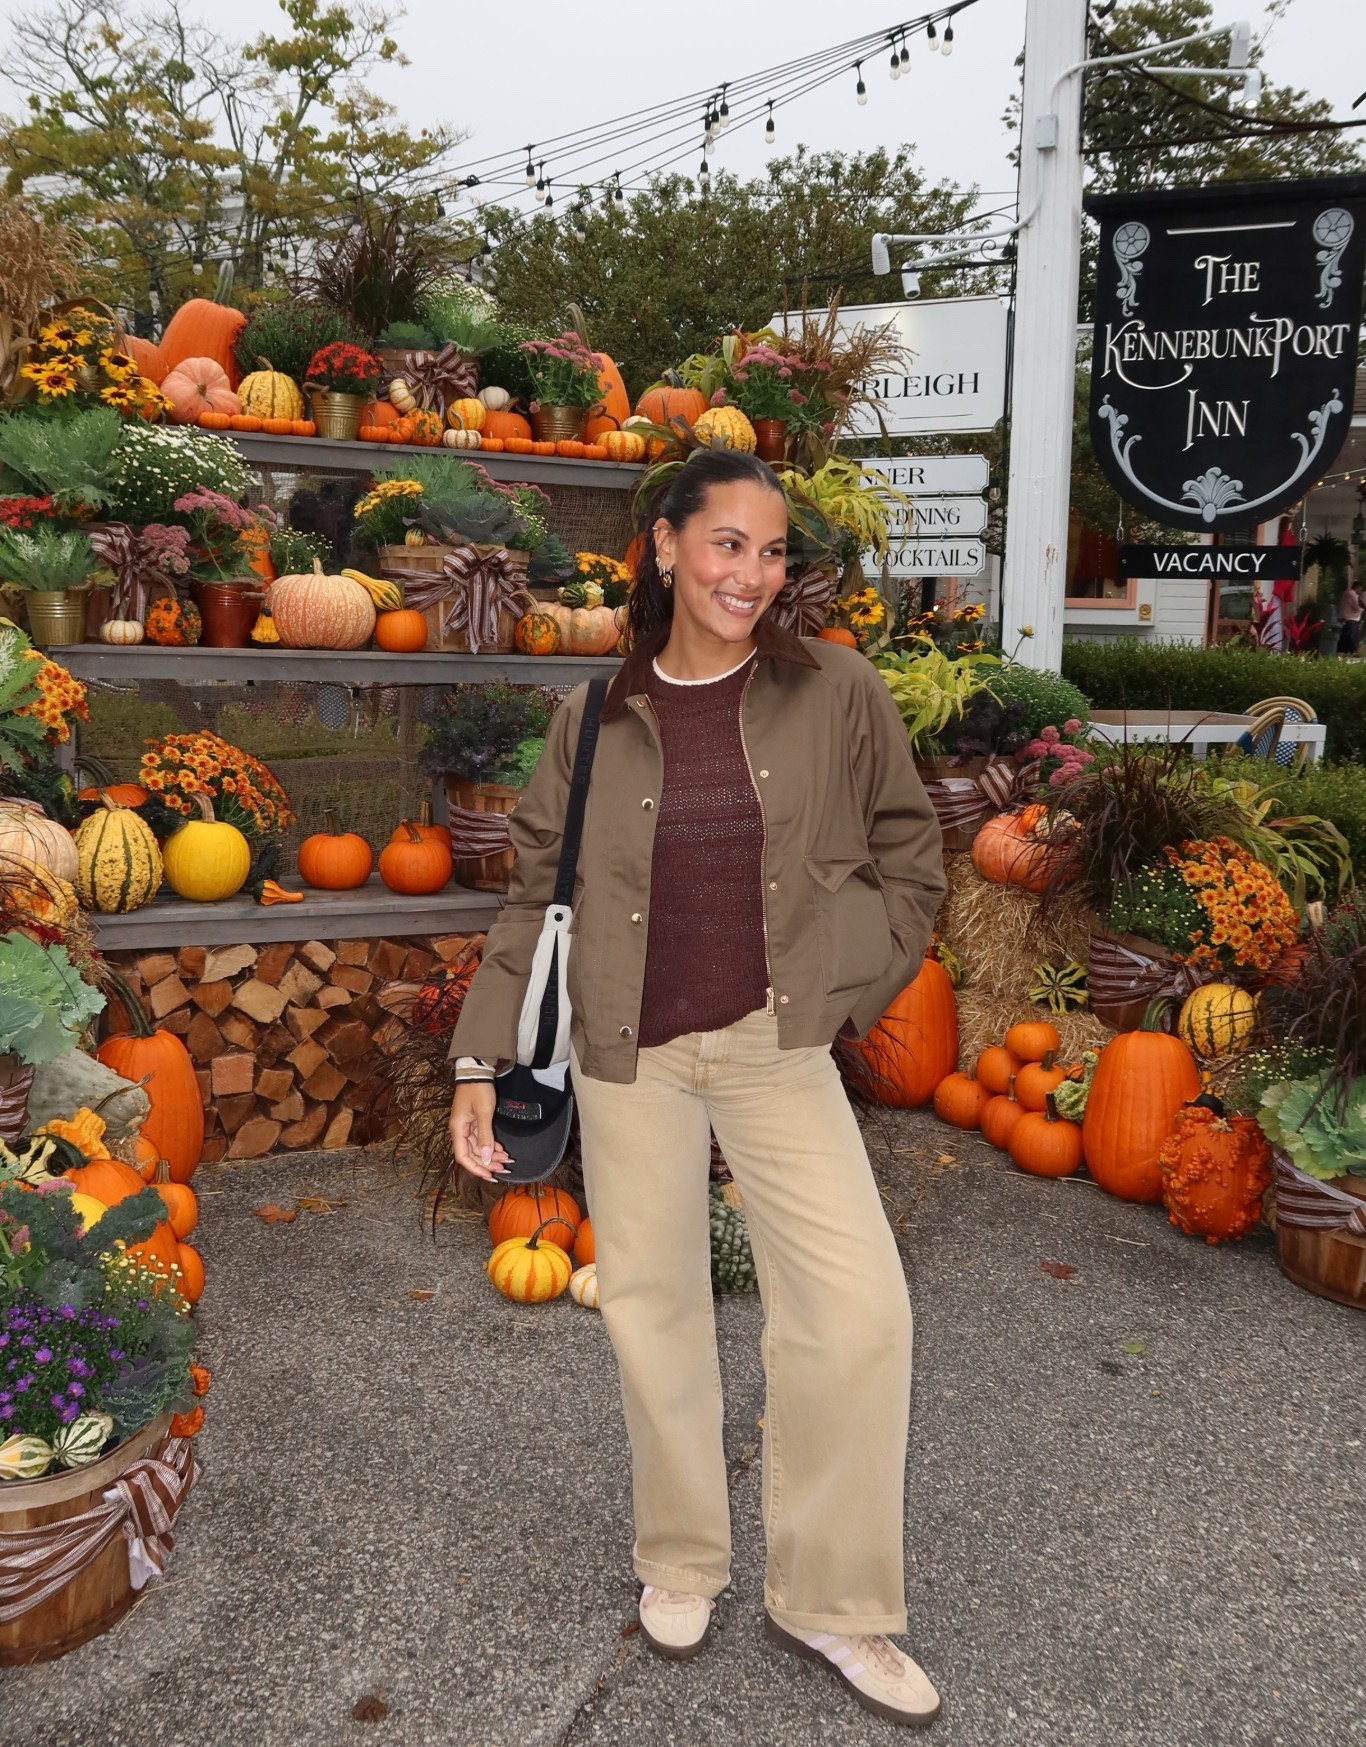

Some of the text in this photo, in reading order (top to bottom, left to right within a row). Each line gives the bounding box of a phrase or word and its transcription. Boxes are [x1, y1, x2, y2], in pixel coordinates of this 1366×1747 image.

[1194, 254, 1261, 307] THE
[1100, 313, 1351, 391] KENNEBUNKPORT
[860, 371, 980, 400] RLEIGH
[1182, 389, 1252, 452] INN
[858, 467, 925, 485] NNER
[896, 507, 961, 526] DINING
[872, 548, 979, 568] COCKTAILS
[1152, 552, 1267, 574] VACANCY
